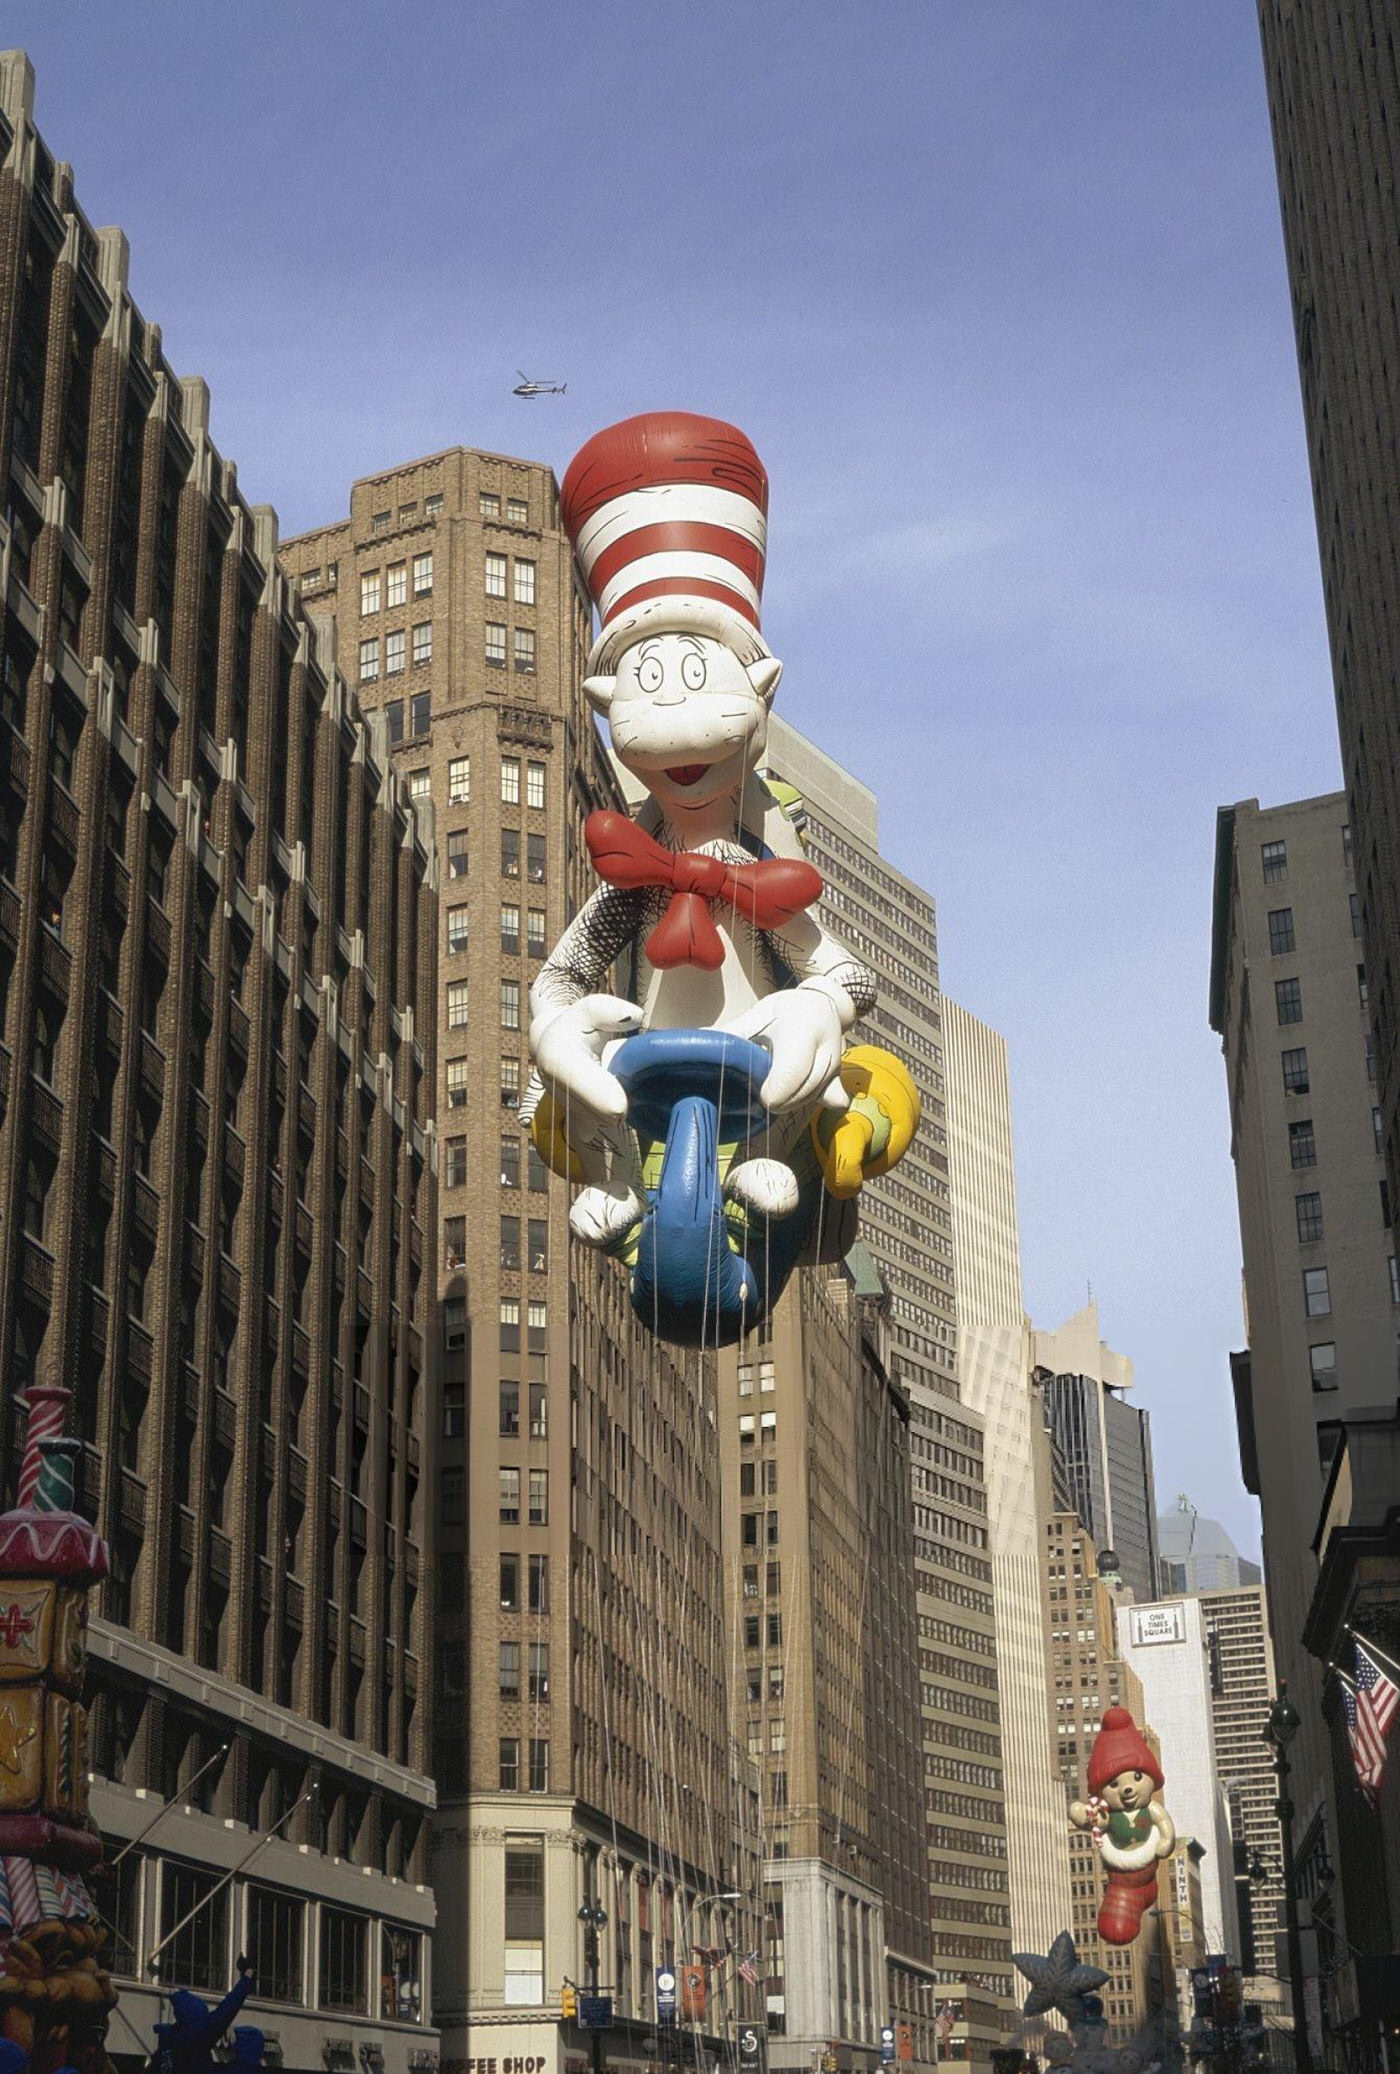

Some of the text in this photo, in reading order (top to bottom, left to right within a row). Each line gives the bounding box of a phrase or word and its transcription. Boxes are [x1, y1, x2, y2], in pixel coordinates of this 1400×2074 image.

[1149, 1613, 1165, 1621] ONE
[1147, 1620, 1169, 1629] TIMES
[1144, 1626, 1172, 1637] SQUARE
[1177, 1857, 1187, 1903] NINTH
[502, 2056, 546, 2074] SHOP
